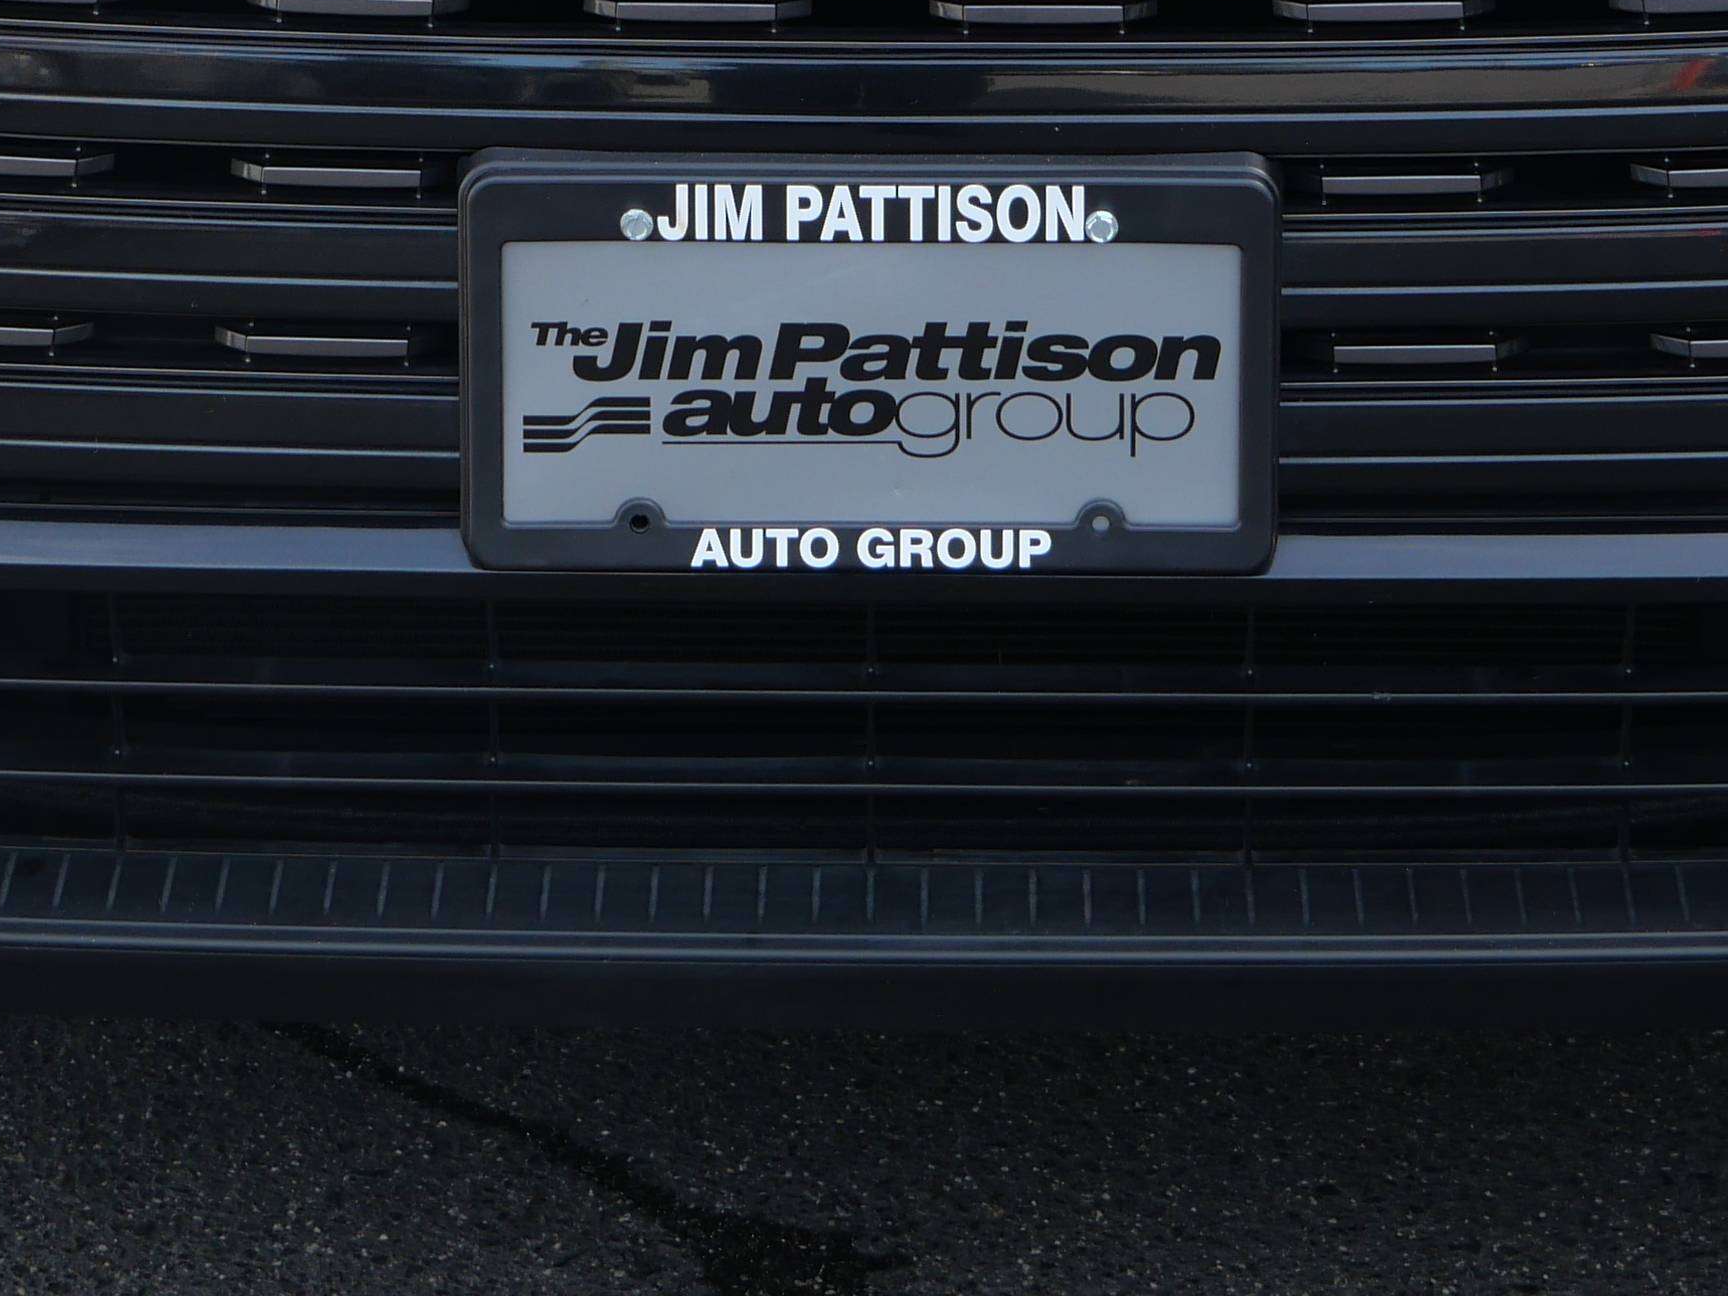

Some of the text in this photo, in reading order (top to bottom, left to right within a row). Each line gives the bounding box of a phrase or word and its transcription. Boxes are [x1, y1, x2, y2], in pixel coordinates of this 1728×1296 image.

[656, 183, 1086, 243] JIM PATTISON
[530, 319, 1222, 383] The Jim Pattison
[690, 527, 1052, 569] AUTO GROUP
